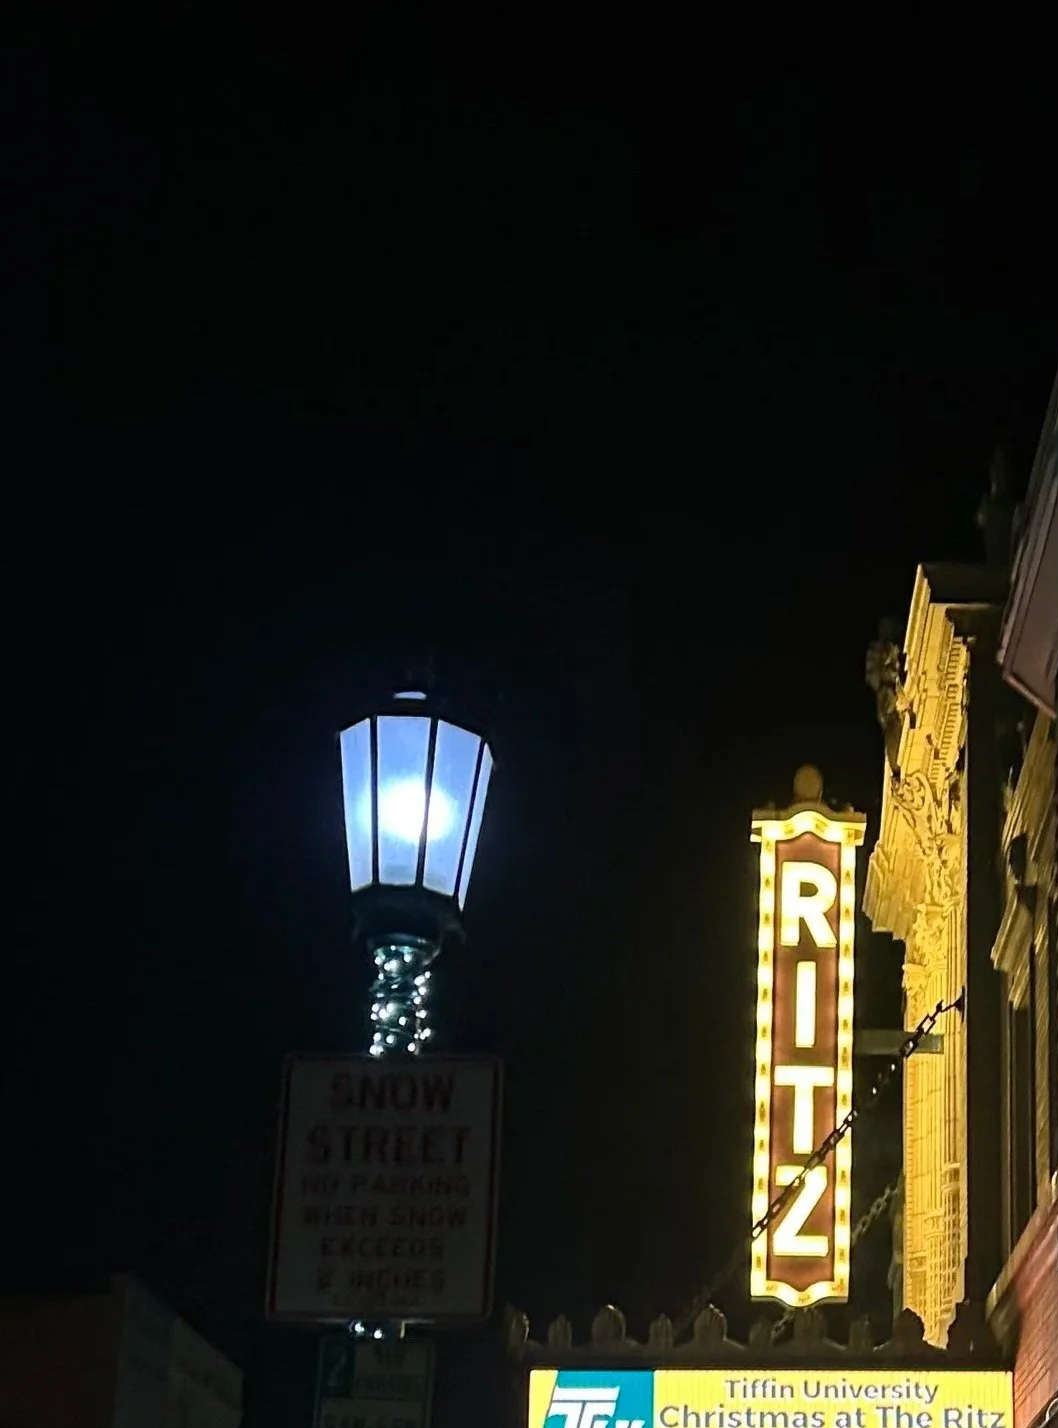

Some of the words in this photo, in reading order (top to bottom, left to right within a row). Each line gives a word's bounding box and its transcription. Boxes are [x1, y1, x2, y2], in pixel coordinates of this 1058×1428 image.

[772, 860, 838, 1257] RITZ
[330, 1072, 455, 1113] SNOW
[307, 1124, 472, 1165] STREET
[302, 1172, 339, 1196] NO
[350, 1172, 472, 1197] PARKING
[302, 1205, 379, 1228] WHEN
[388, 1205, 468, 1228] SNOW
[321, 1235, 445, 1260] EXCEEDS
[349, 1267, 447, 1291] INCHES
[724, 1379, 795, 1400] Tiffin
[803, 1379, 939, 1404] University
[659, 1404, 826, 1428] Christmas
[835, 1406, 867, 1428] at
